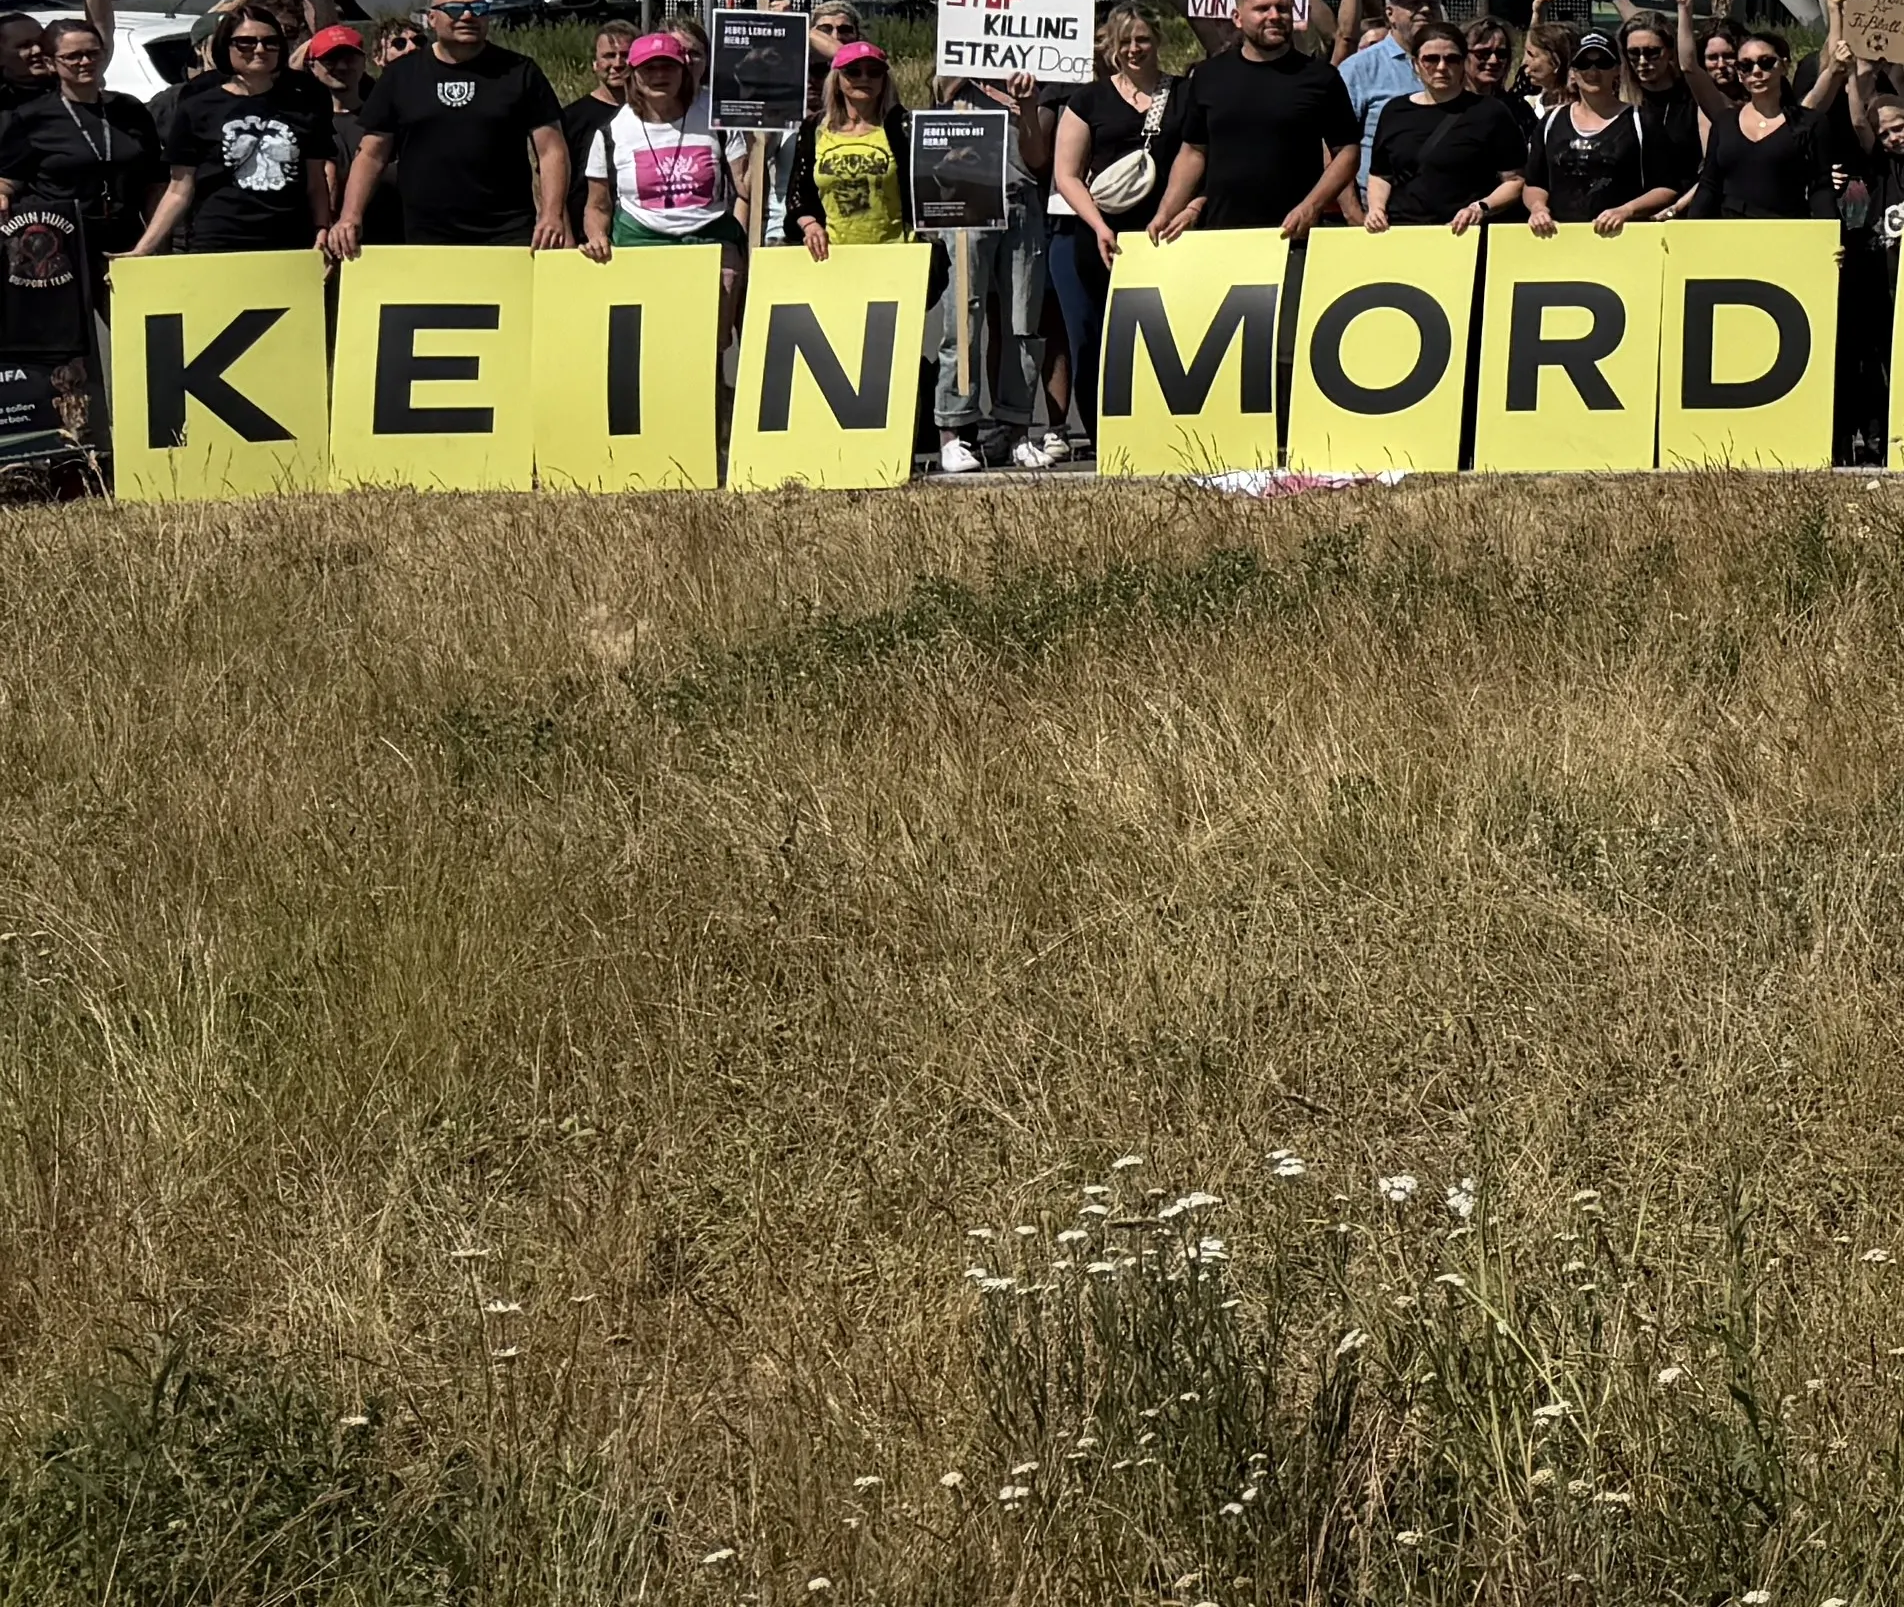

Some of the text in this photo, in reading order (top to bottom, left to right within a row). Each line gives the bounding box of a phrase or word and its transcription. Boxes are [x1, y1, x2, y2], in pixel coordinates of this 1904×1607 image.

[984, 13, 1079, 42] KILLING
[945, 40, 1095, 82] STRAY Dogs
[145, 301, 899, 449] KEIN
[1101, 278, 1812, 418] MORD
